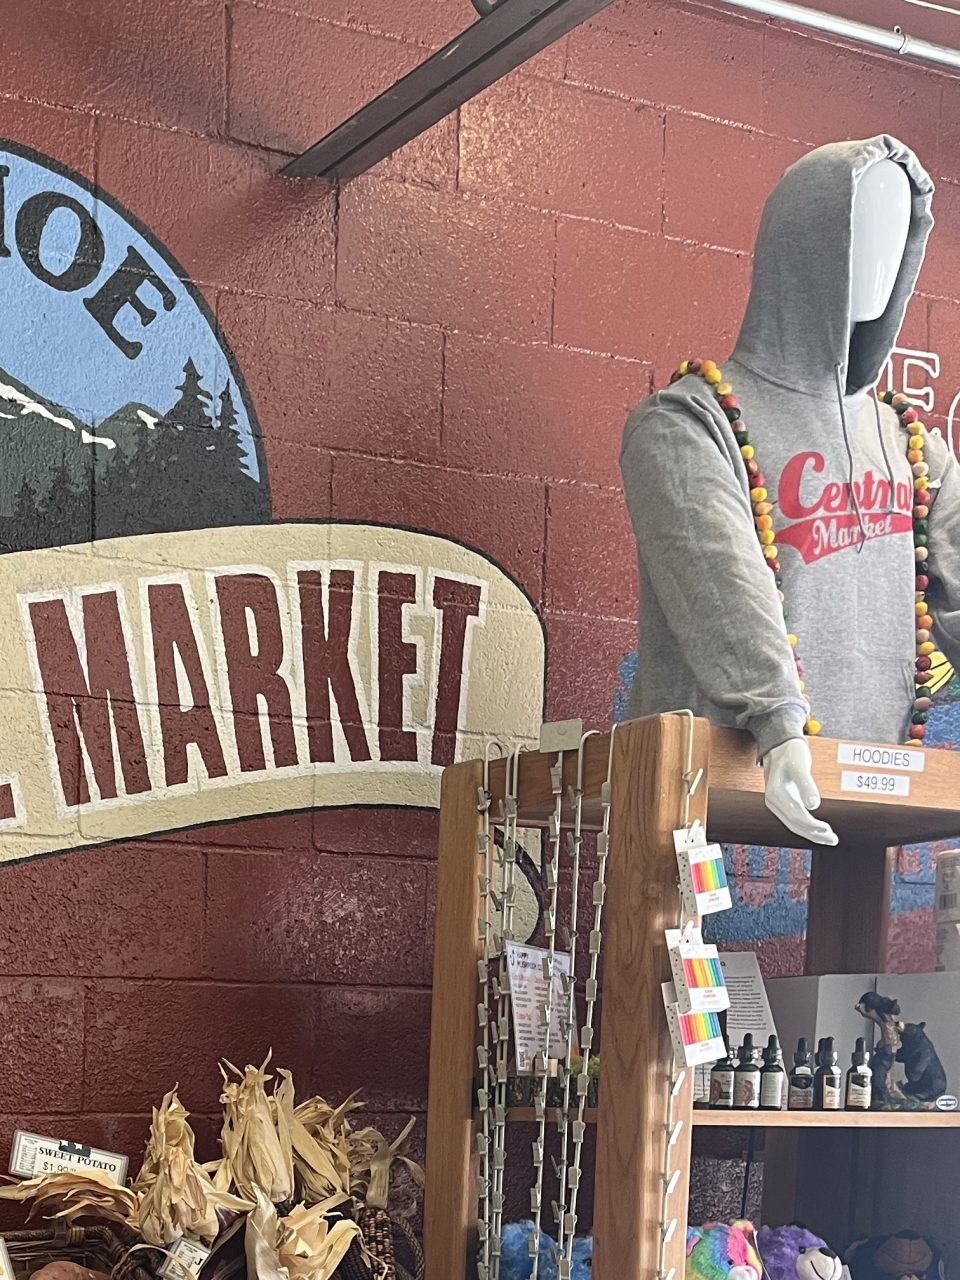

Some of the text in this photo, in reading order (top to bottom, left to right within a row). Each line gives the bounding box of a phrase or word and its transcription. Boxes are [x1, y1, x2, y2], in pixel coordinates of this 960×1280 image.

[813, 515, 893, 556] Market
[26, 560, 490, 817] MARKET
[853, 748, 910, 767] HOODIES
[856, 776, 895, 792] $49.99
[38, 1146, 76, 1162] SWEET
[77, 1156, 116, 1172] POTATO
